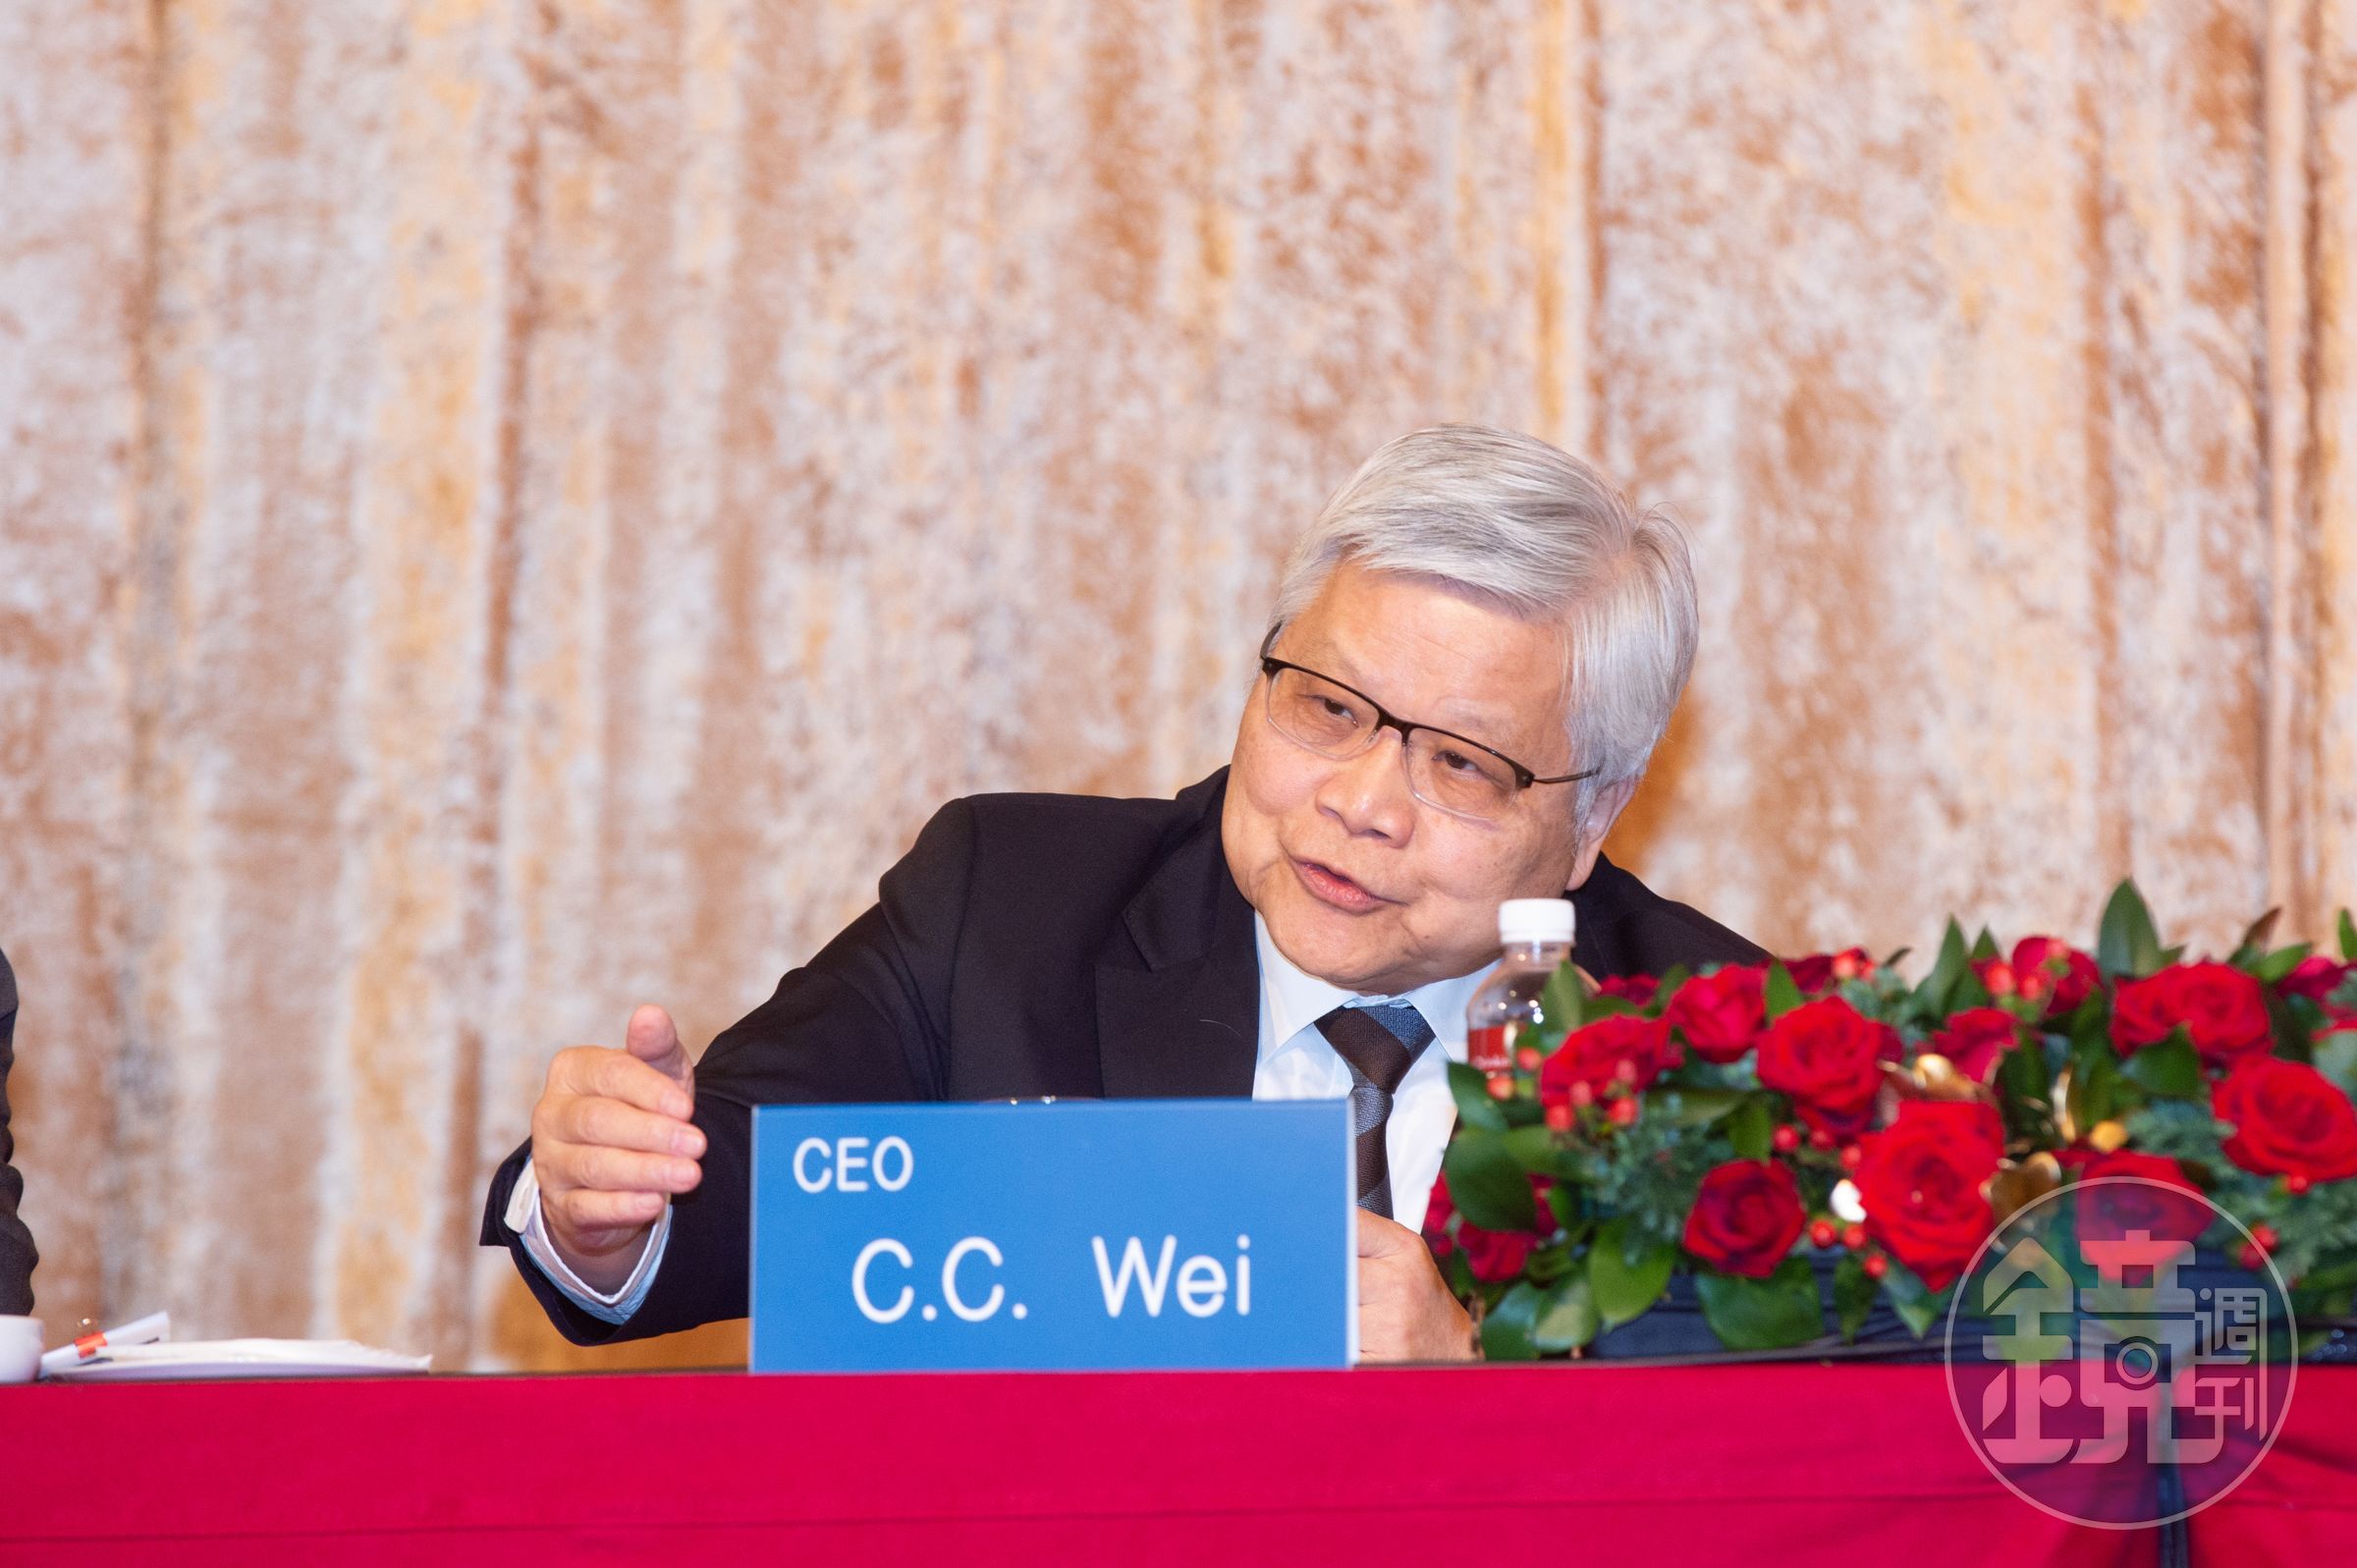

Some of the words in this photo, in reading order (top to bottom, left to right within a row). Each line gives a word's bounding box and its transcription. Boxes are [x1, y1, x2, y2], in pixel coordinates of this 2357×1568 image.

[793, 1136, 914, 1193] CEO
[852, 1236, 1028, 1324] C.C.
[1092, 1234, 1251, 1318] Wei
